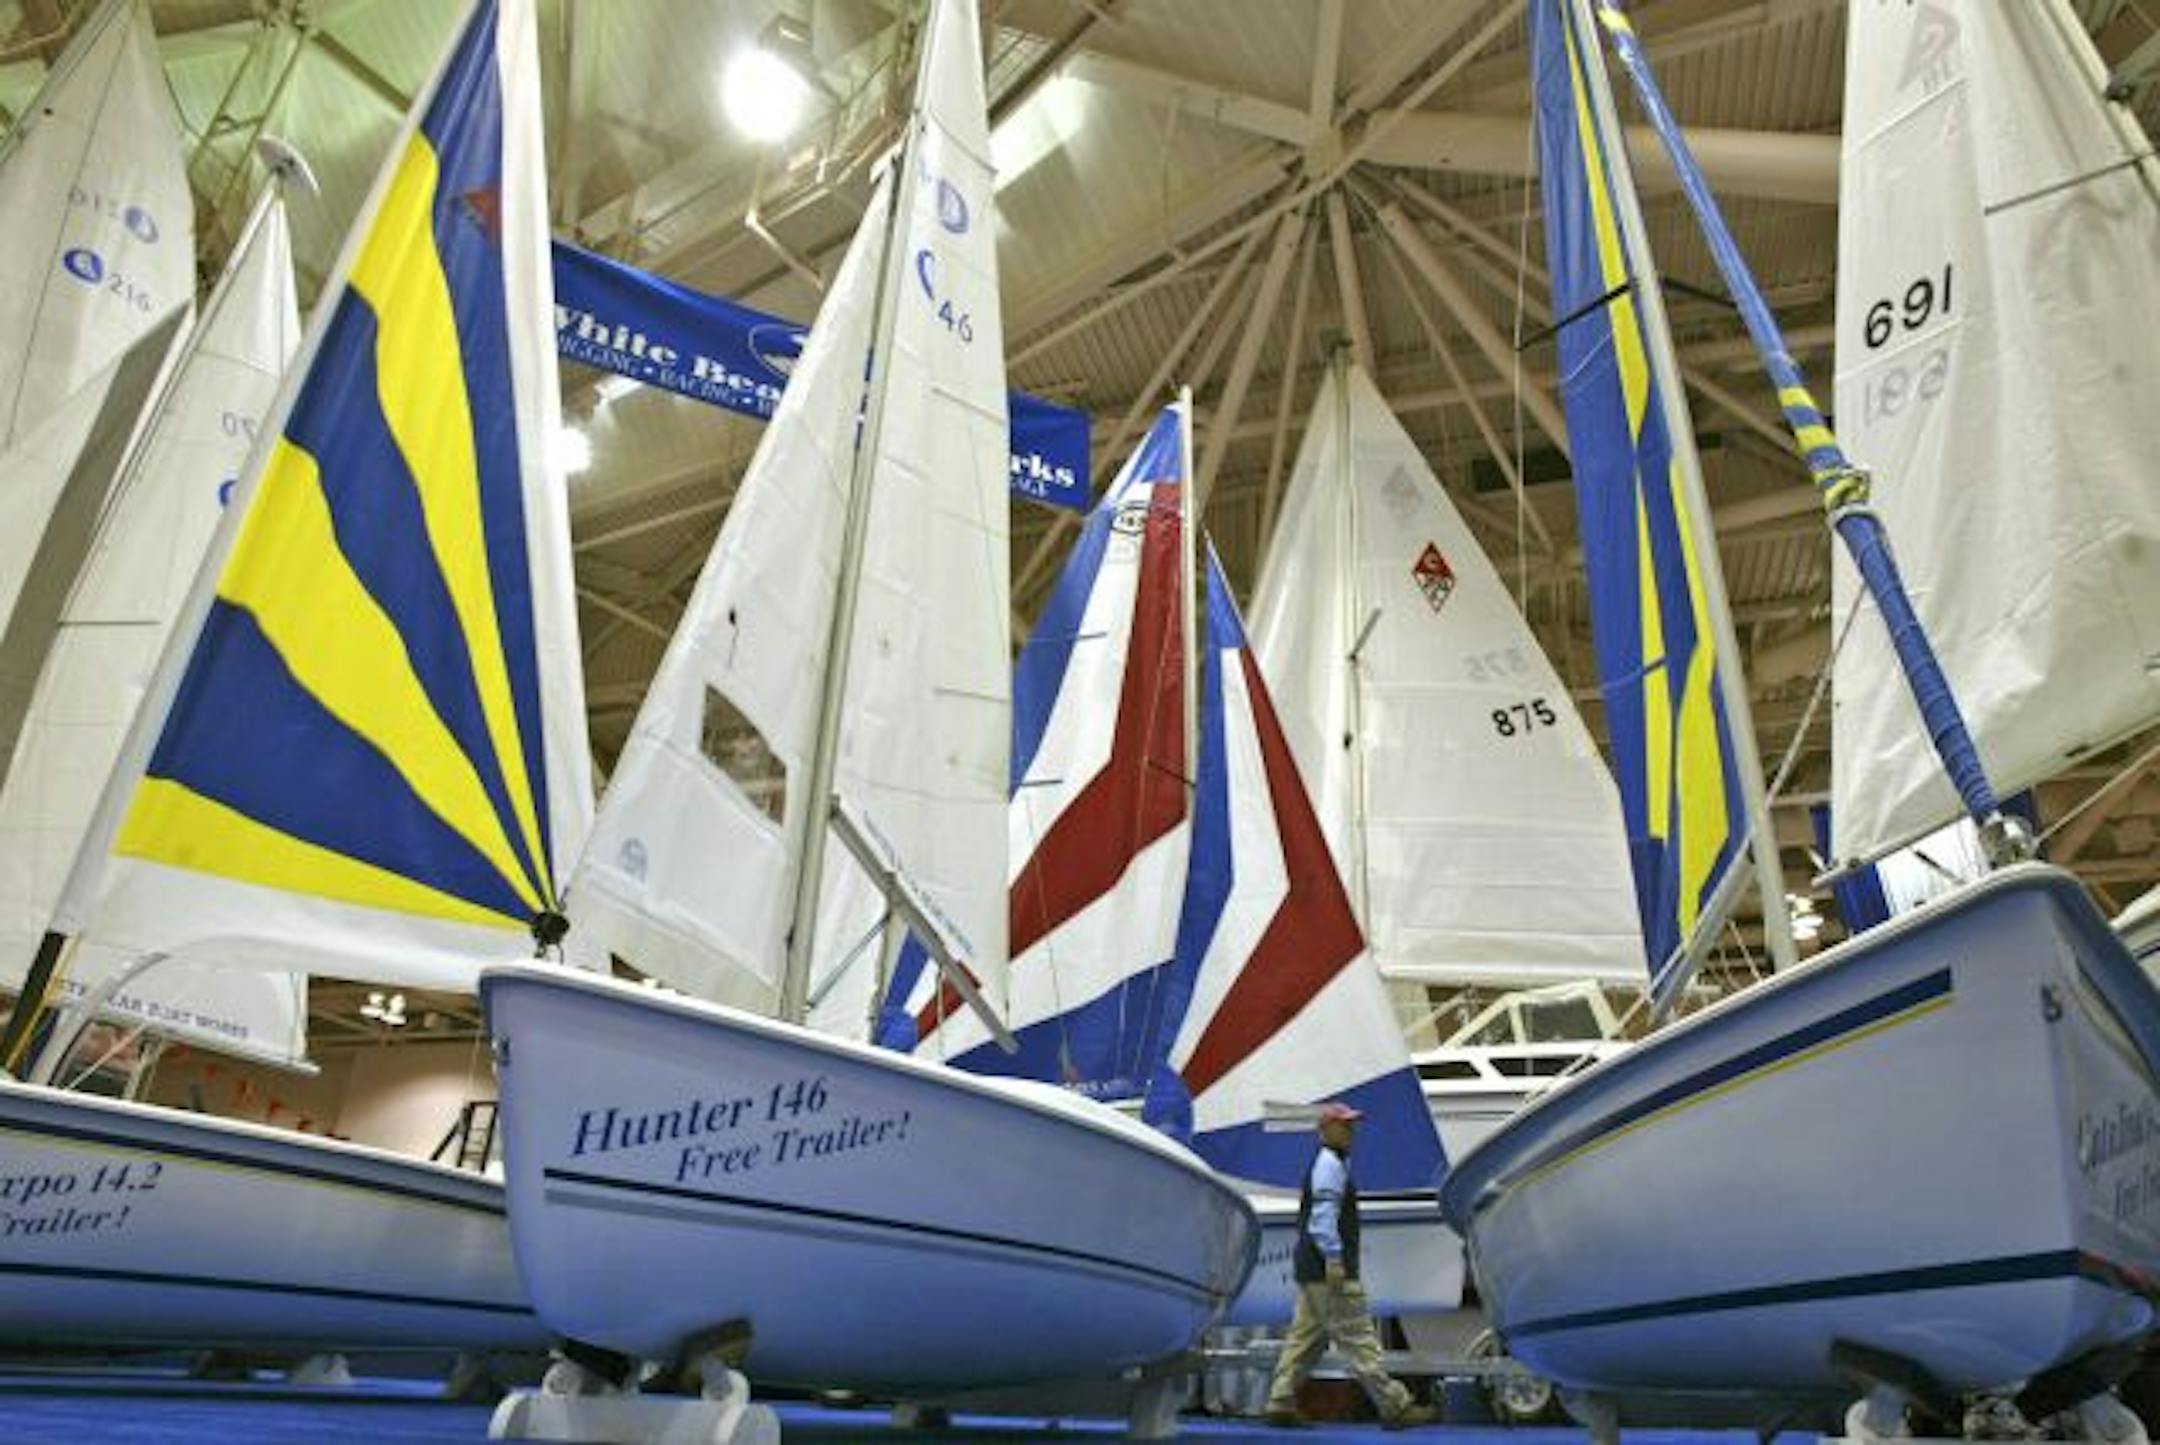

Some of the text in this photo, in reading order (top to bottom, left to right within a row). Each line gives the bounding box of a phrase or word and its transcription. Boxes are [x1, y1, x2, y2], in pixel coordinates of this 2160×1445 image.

[109, 272, 151, 312] 216
[1864, 263, 1952, 349] 691
[937, 300, 973, 344] 46
[1011, 453, 1076, 489] rks
[1492, 699, 1556, 737] 875
[569, 1076, 829, 1158] Hunter 146
[675, 1110, 911, 1182] Free Trailer!
[89, 1160, 163, 1194] 14.2
